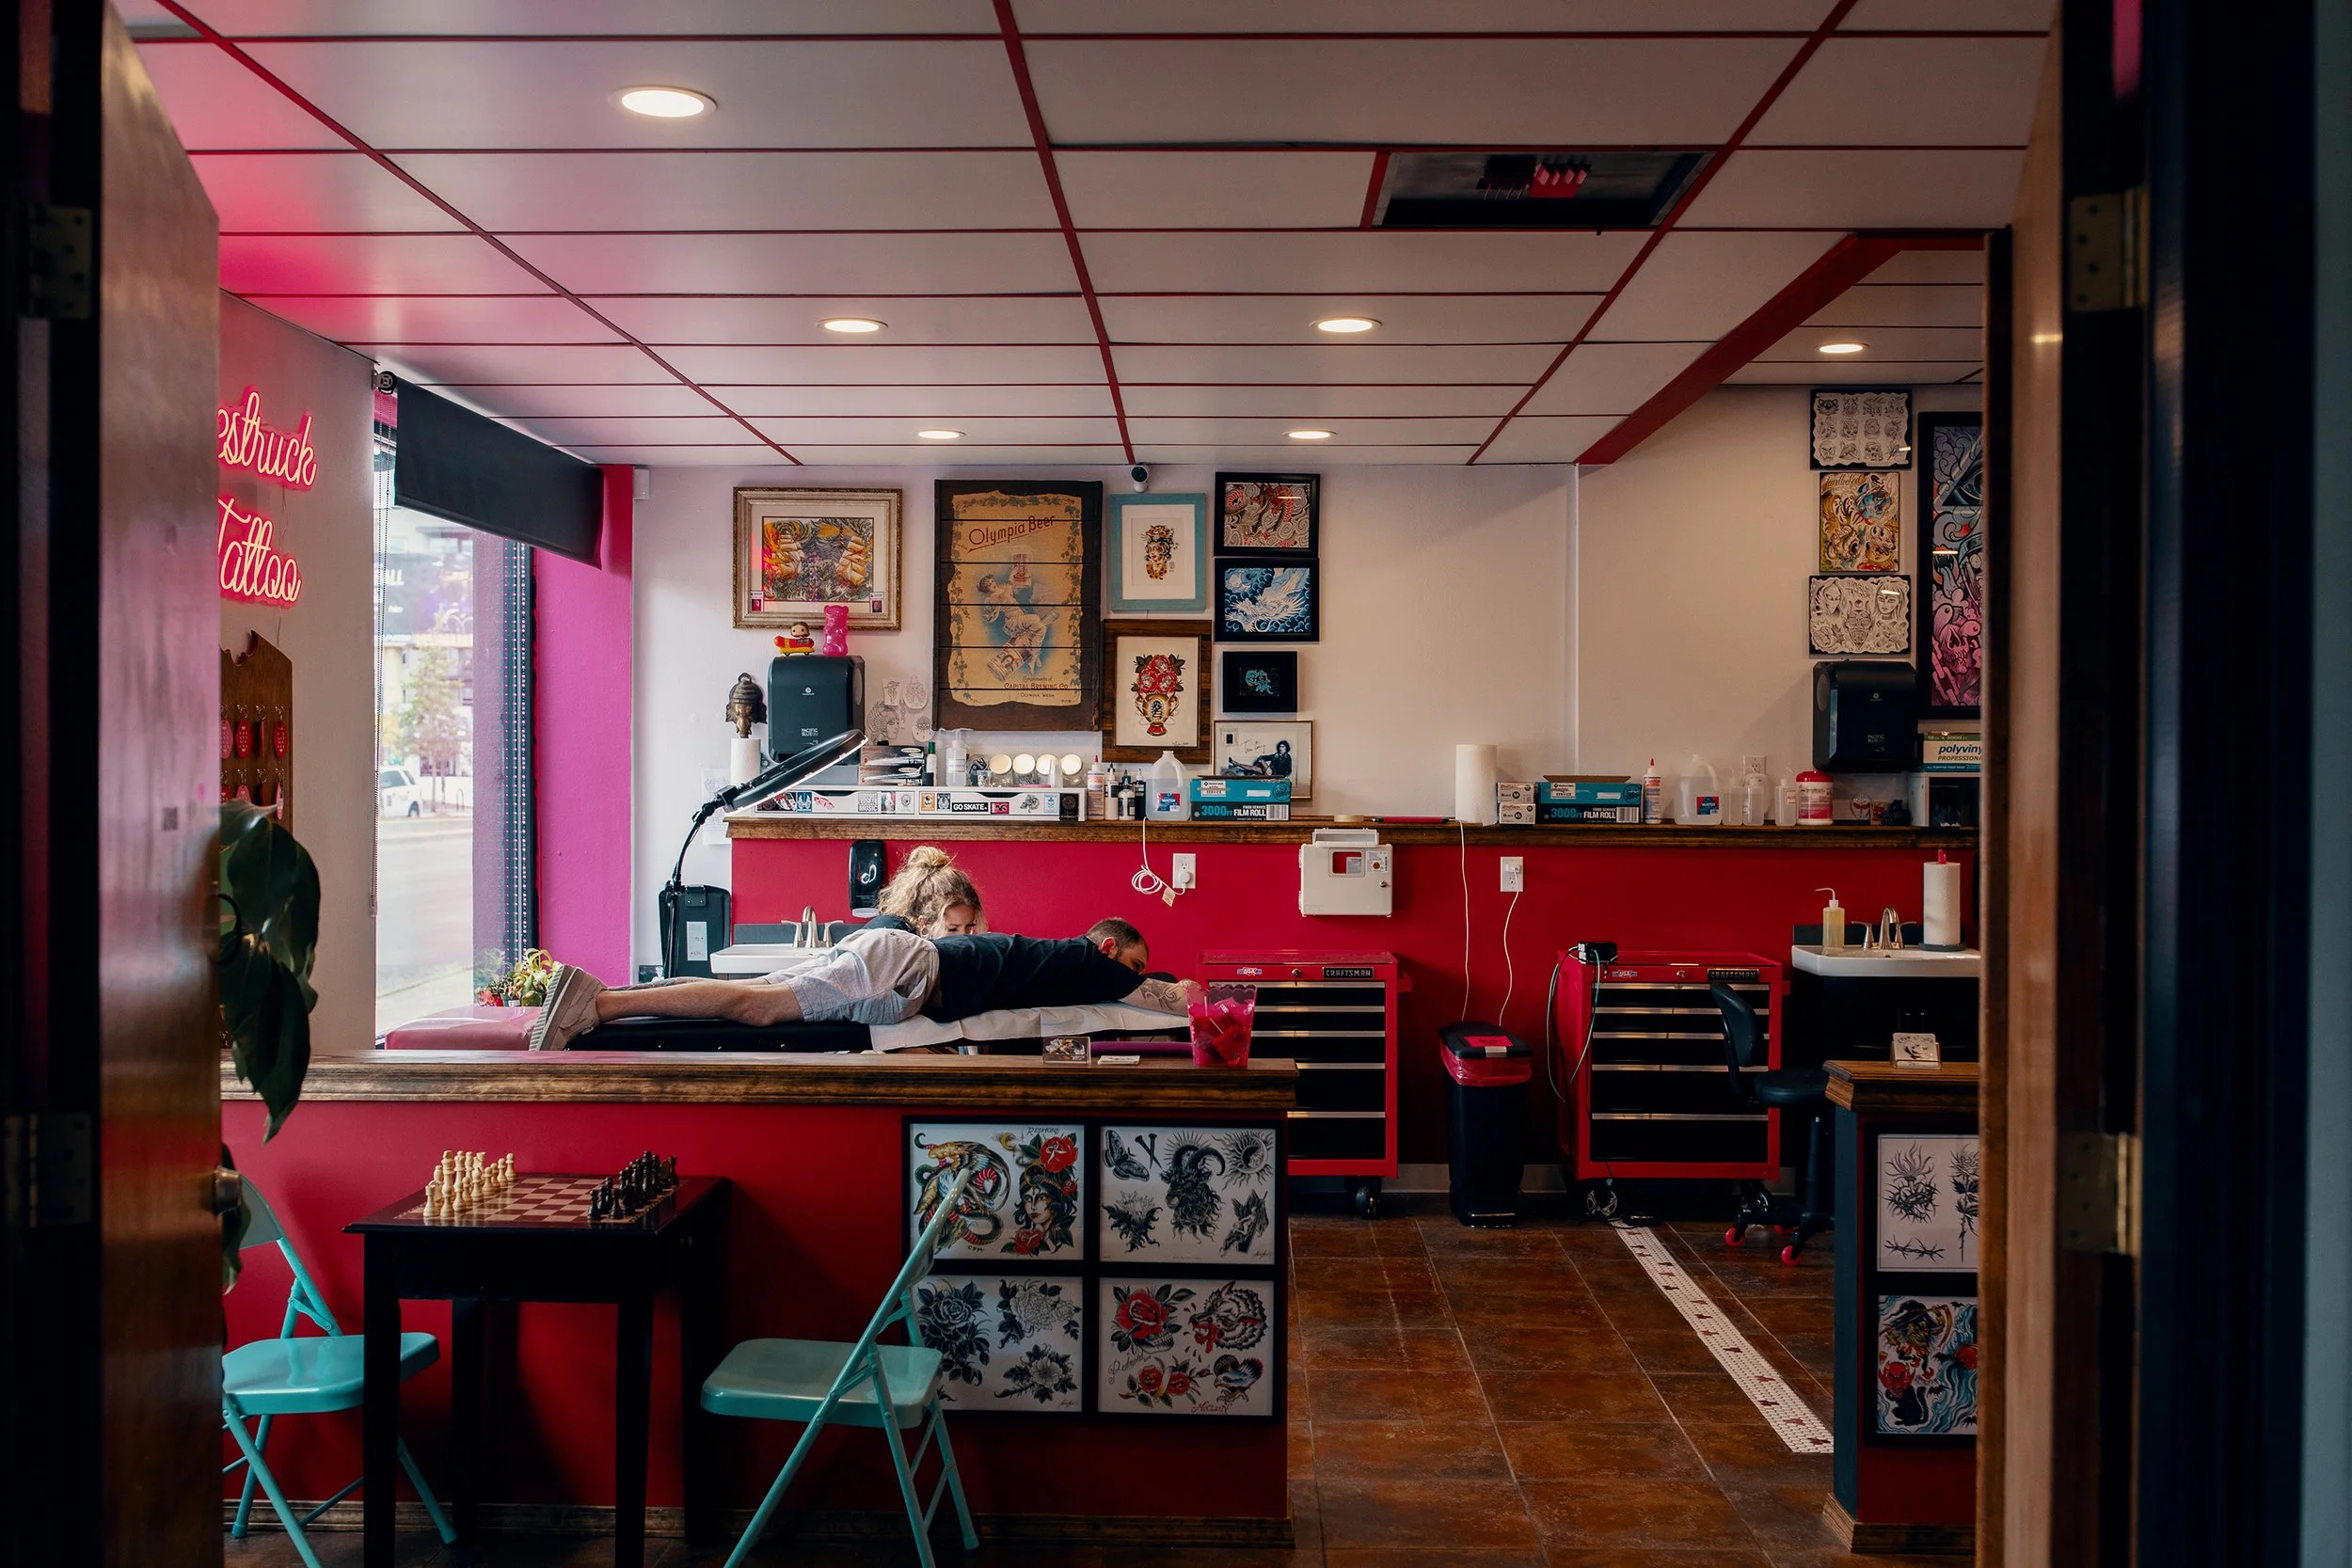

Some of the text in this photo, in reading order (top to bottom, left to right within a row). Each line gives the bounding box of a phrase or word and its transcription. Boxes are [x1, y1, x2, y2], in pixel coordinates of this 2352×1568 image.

[969, 515, 1056, 545] Olympia Beer
[1710, 971, 1756, 979] CRAFTSMAN
